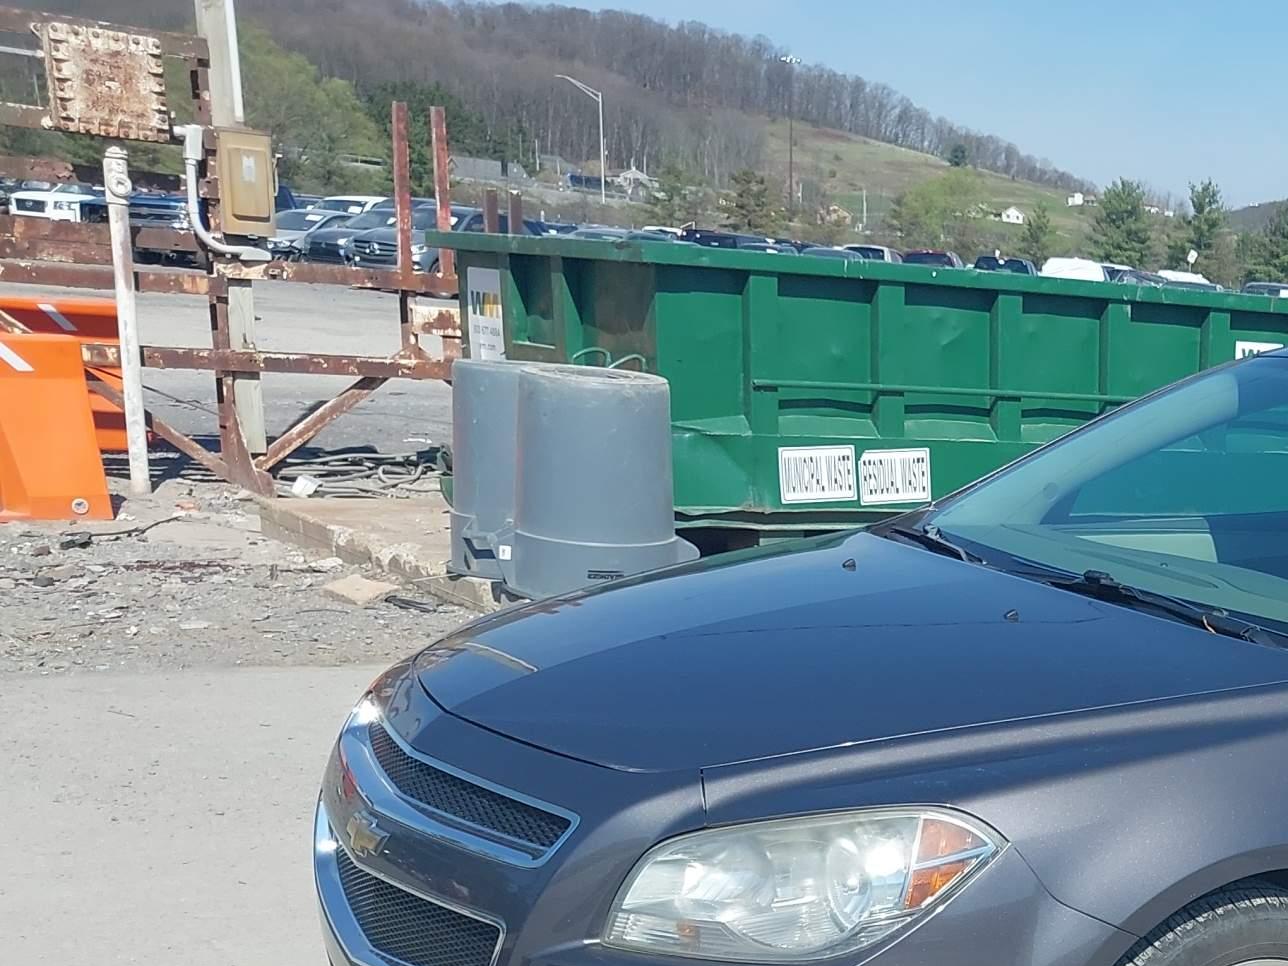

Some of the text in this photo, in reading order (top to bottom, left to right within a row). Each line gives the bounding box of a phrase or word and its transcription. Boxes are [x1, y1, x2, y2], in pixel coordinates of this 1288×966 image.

[470, 289, 500, 319] WM
[783, 455, 852, 494] MUNICIPAL WASTE
[862, 457, 926, 496] RESIDUAL WASTE
